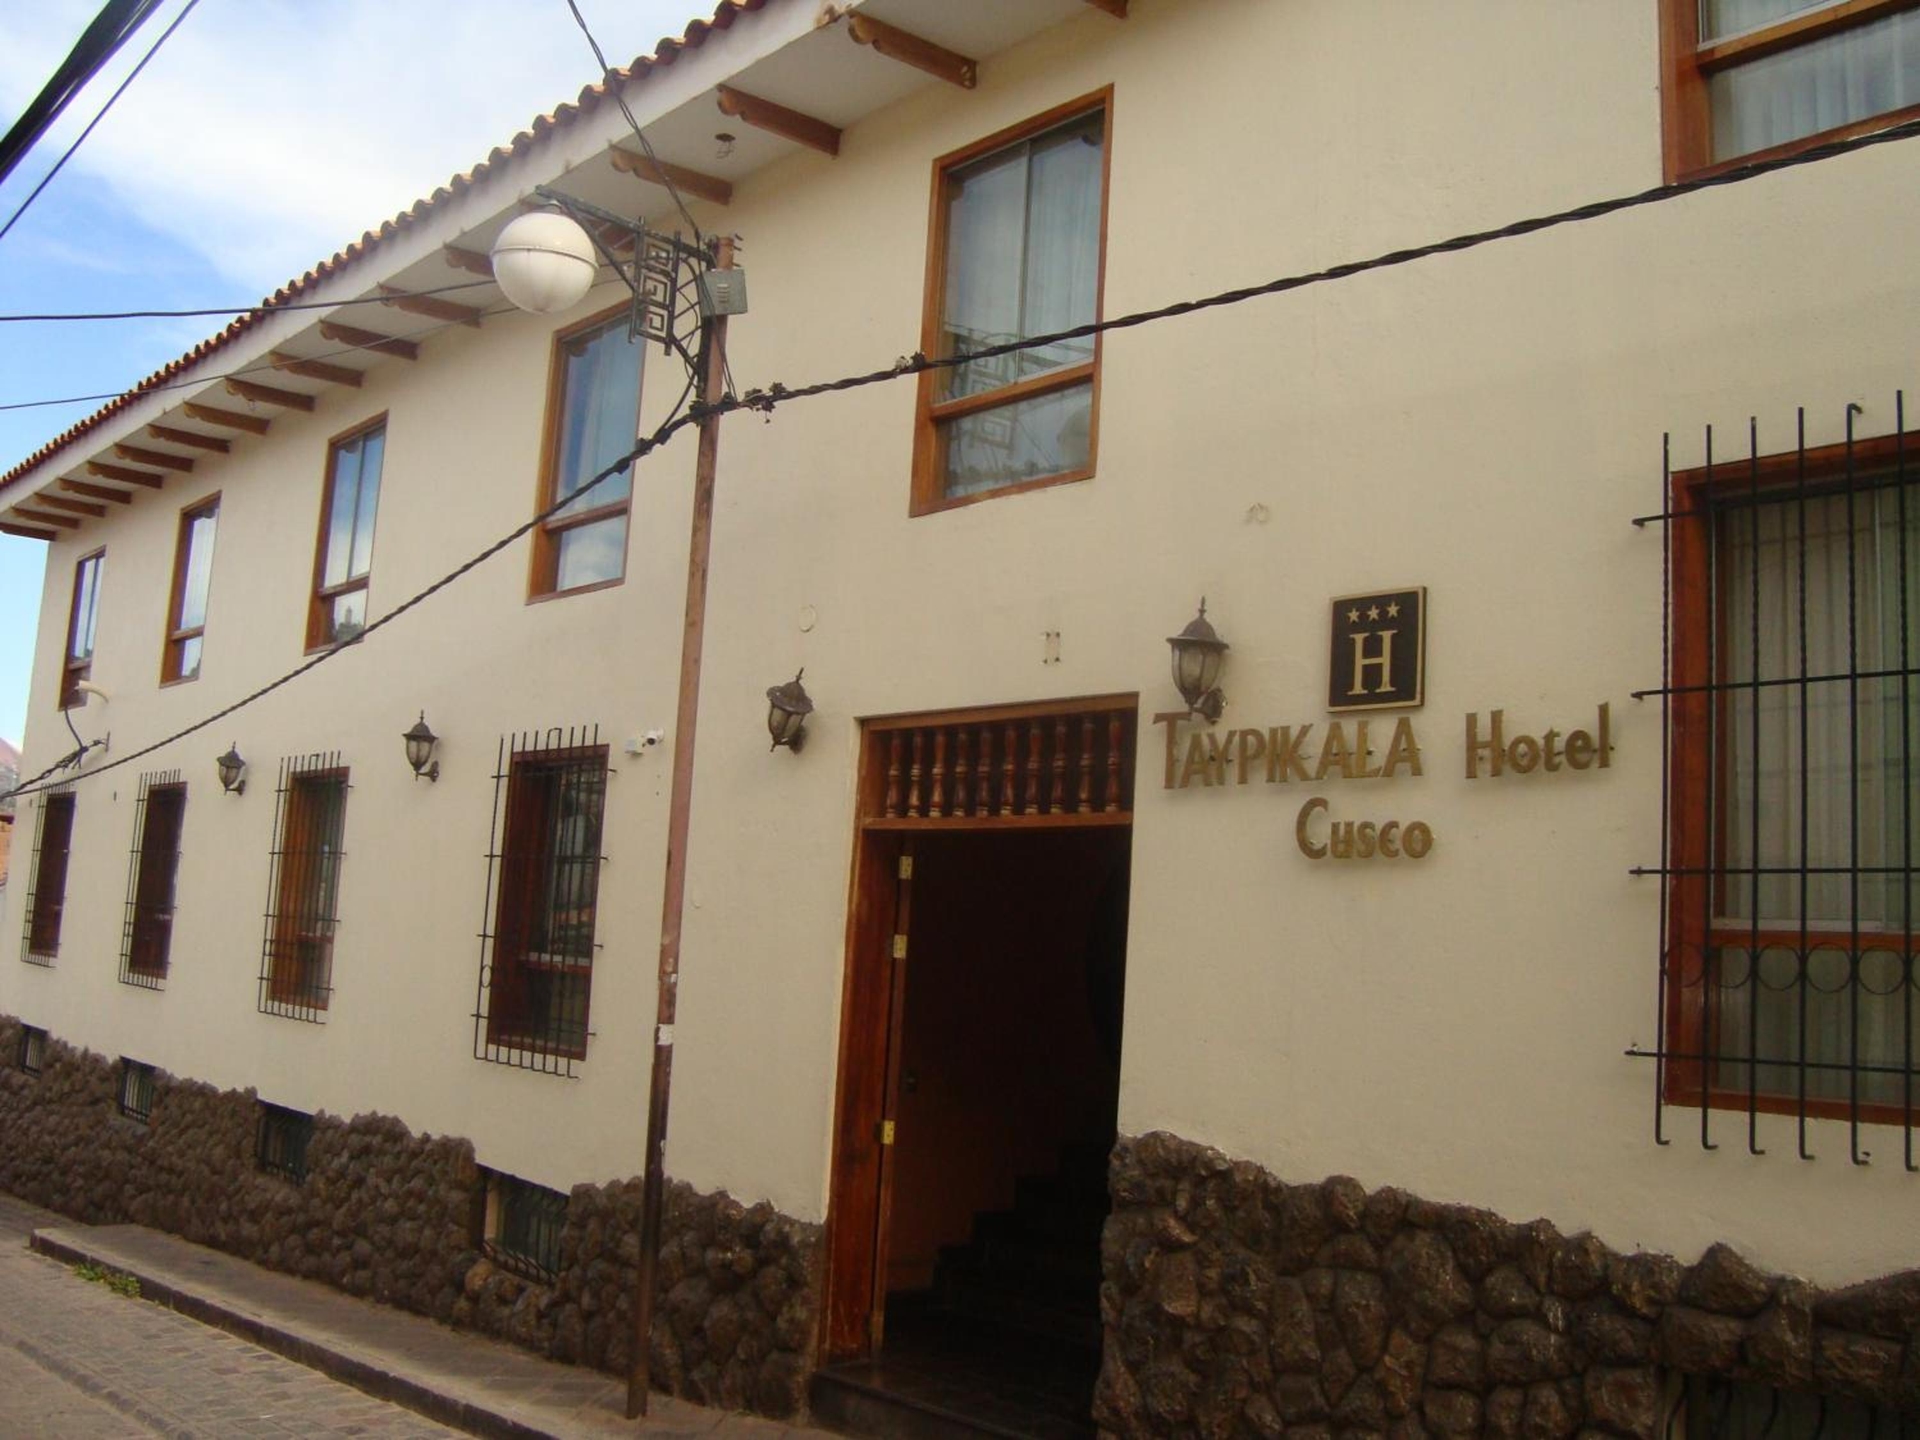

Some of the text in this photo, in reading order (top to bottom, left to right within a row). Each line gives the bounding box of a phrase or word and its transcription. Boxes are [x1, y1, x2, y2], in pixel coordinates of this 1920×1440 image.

[1347, 629, 1398, 696] H
[1153, 702, 1612, 790] TAYPIKALA Hotel
[1296, 797, 1434, 860] Cusco
